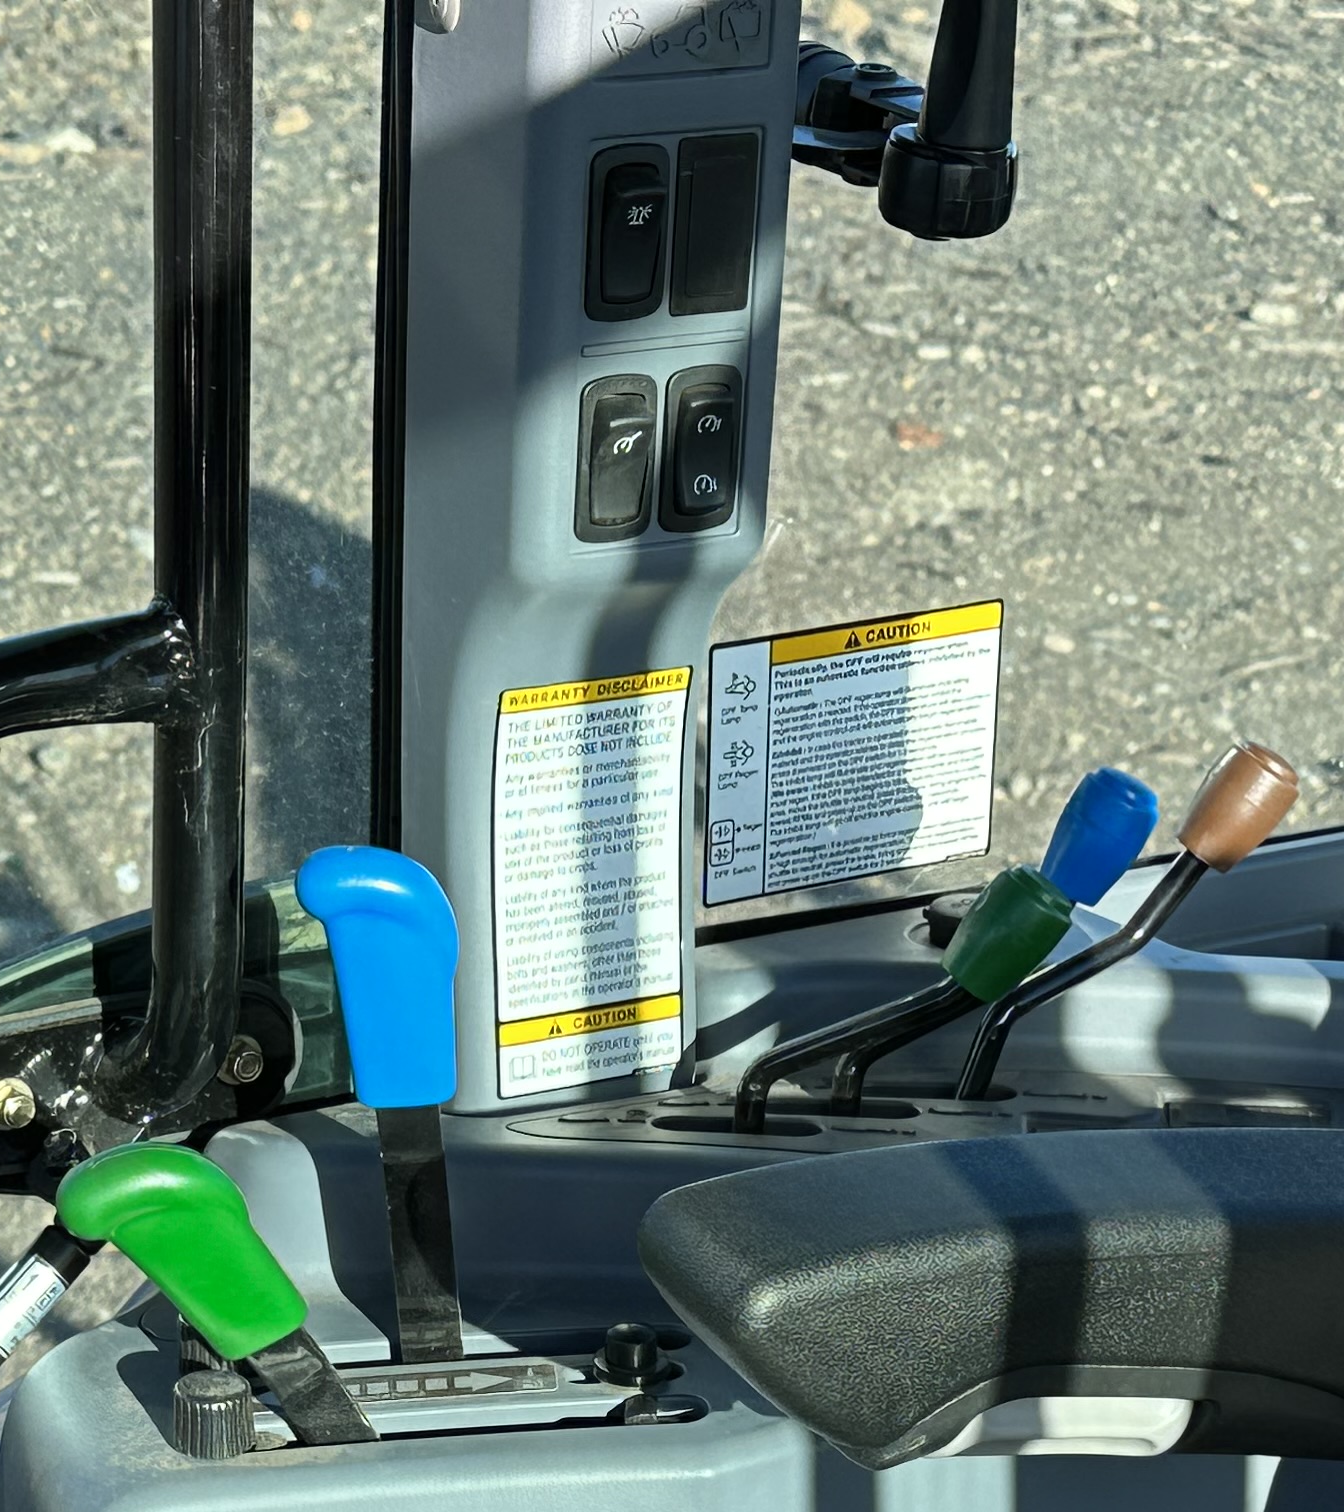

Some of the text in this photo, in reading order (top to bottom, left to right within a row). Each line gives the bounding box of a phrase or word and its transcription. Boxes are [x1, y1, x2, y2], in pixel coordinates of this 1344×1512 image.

[865, 621, 931, 644] CAUTION
[509, 673, 683, 707] WARRANTY DISCLAIMER
[507, 715, 675, 749] THE MANUFACTURER FOR ITS
[508, 701, 672, 733] THE LIMITED WARRANTY OF
[505, 747, 563, 766] PRODUCTS
[600, 737, 623, 753] NOT
[626, 730, 672, 748] INCLUDE
[573, 1006, 636, 1030] CAUTION
[542, 1048, 556, 1062] DO
[560, 1043, 582, 1058] NOT
[584, 1035, 629, 1056] OPERATE
